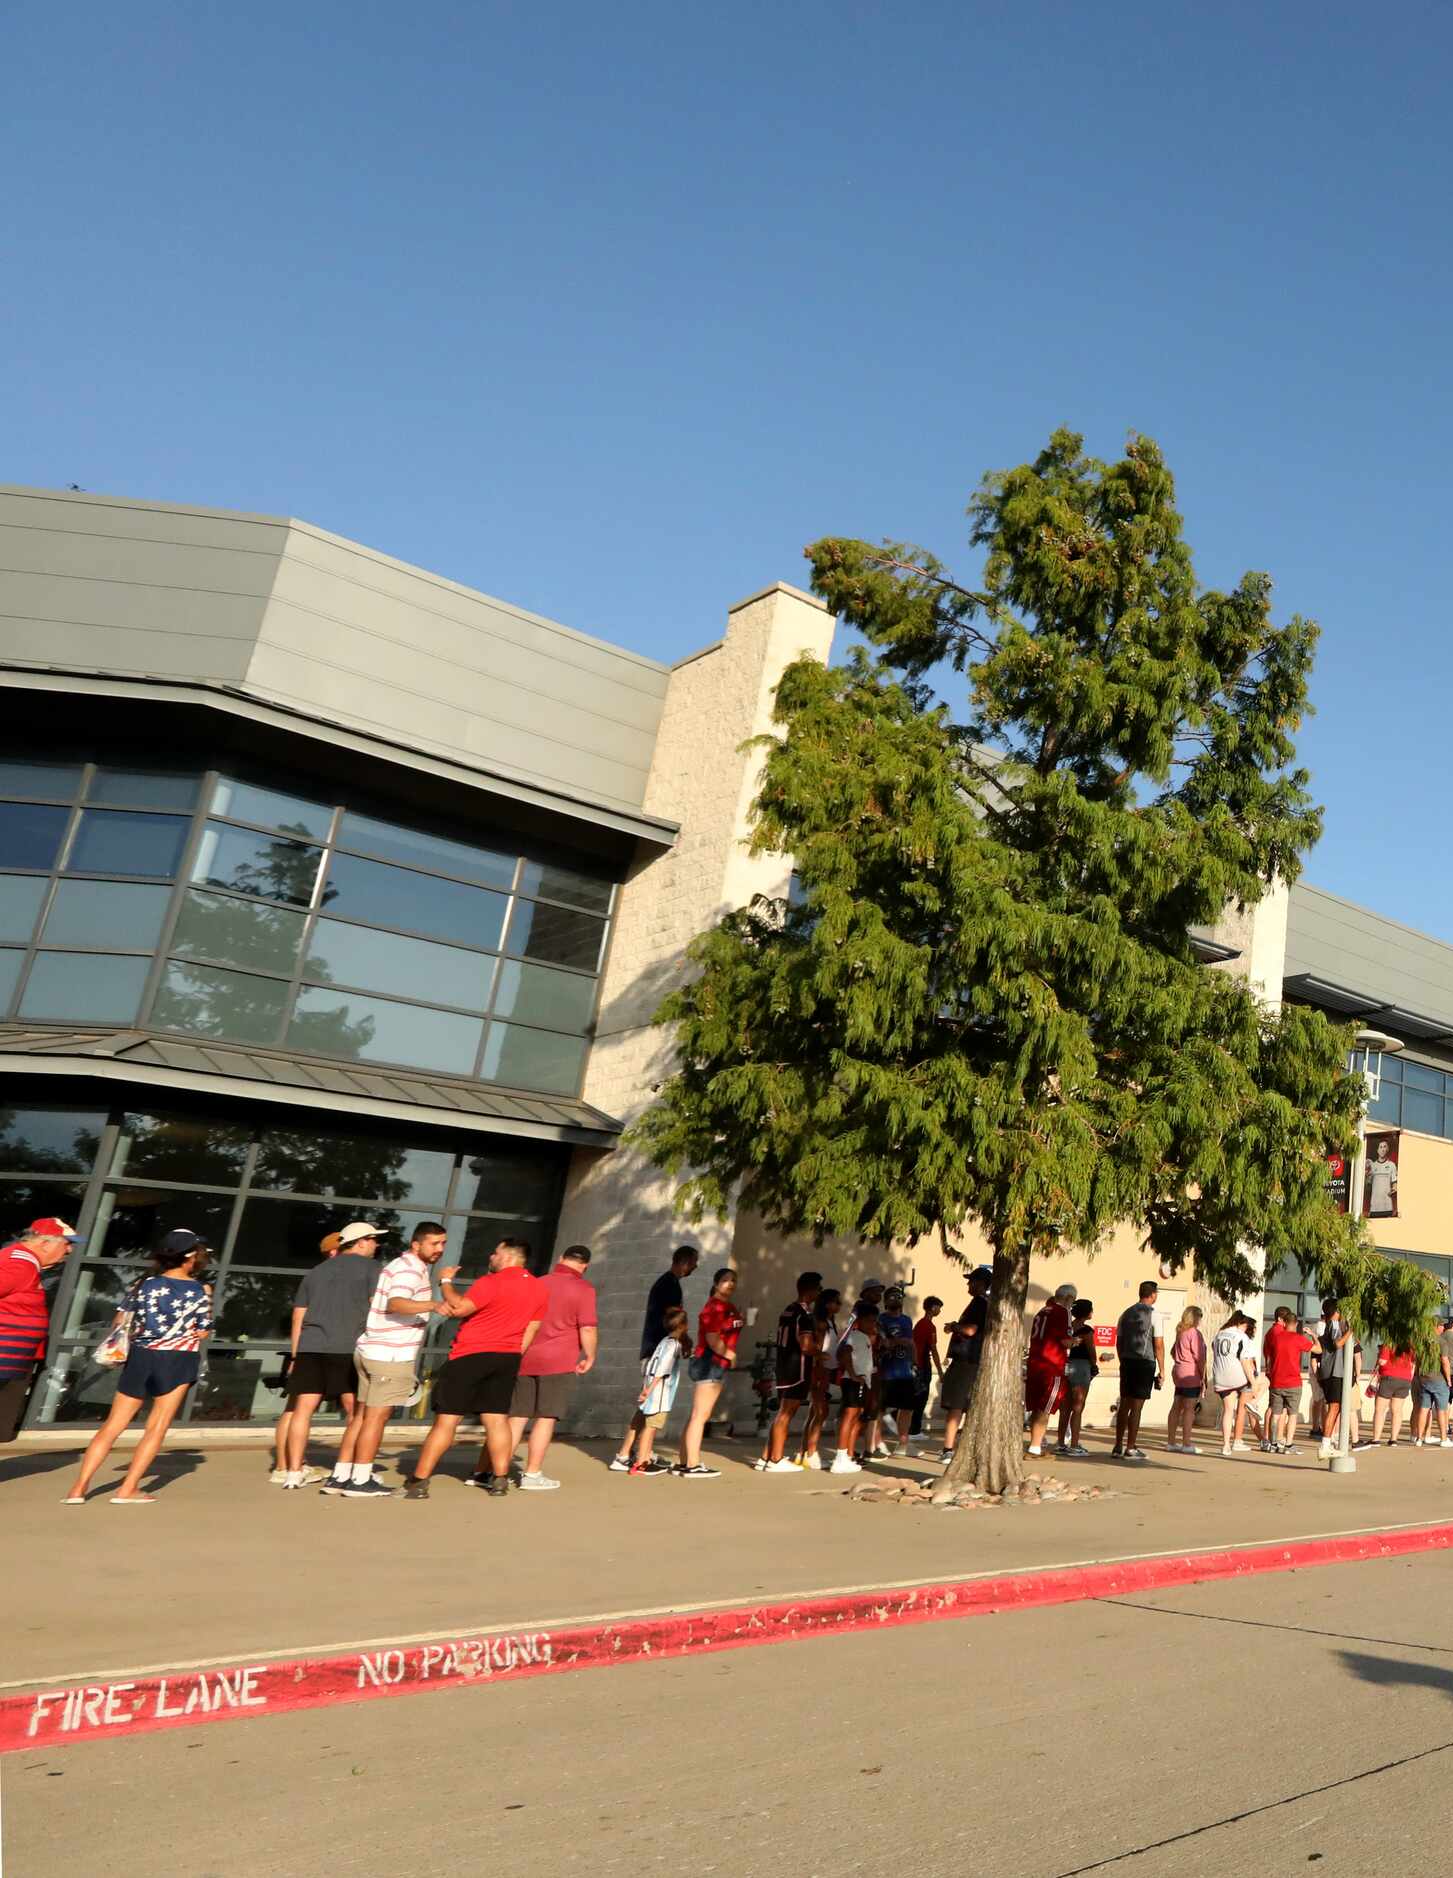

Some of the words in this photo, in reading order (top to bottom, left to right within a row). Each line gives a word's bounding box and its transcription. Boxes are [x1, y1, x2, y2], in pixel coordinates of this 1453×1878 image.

[1097, 1327, 1113, 1336] FDC
[357, 1649, 405, 1688] NO
[422, 1632, 552, 1678] PARKING
[27, 1683, 136, 1737] FIRE
[155, 1666, 268, 1718] LANE
